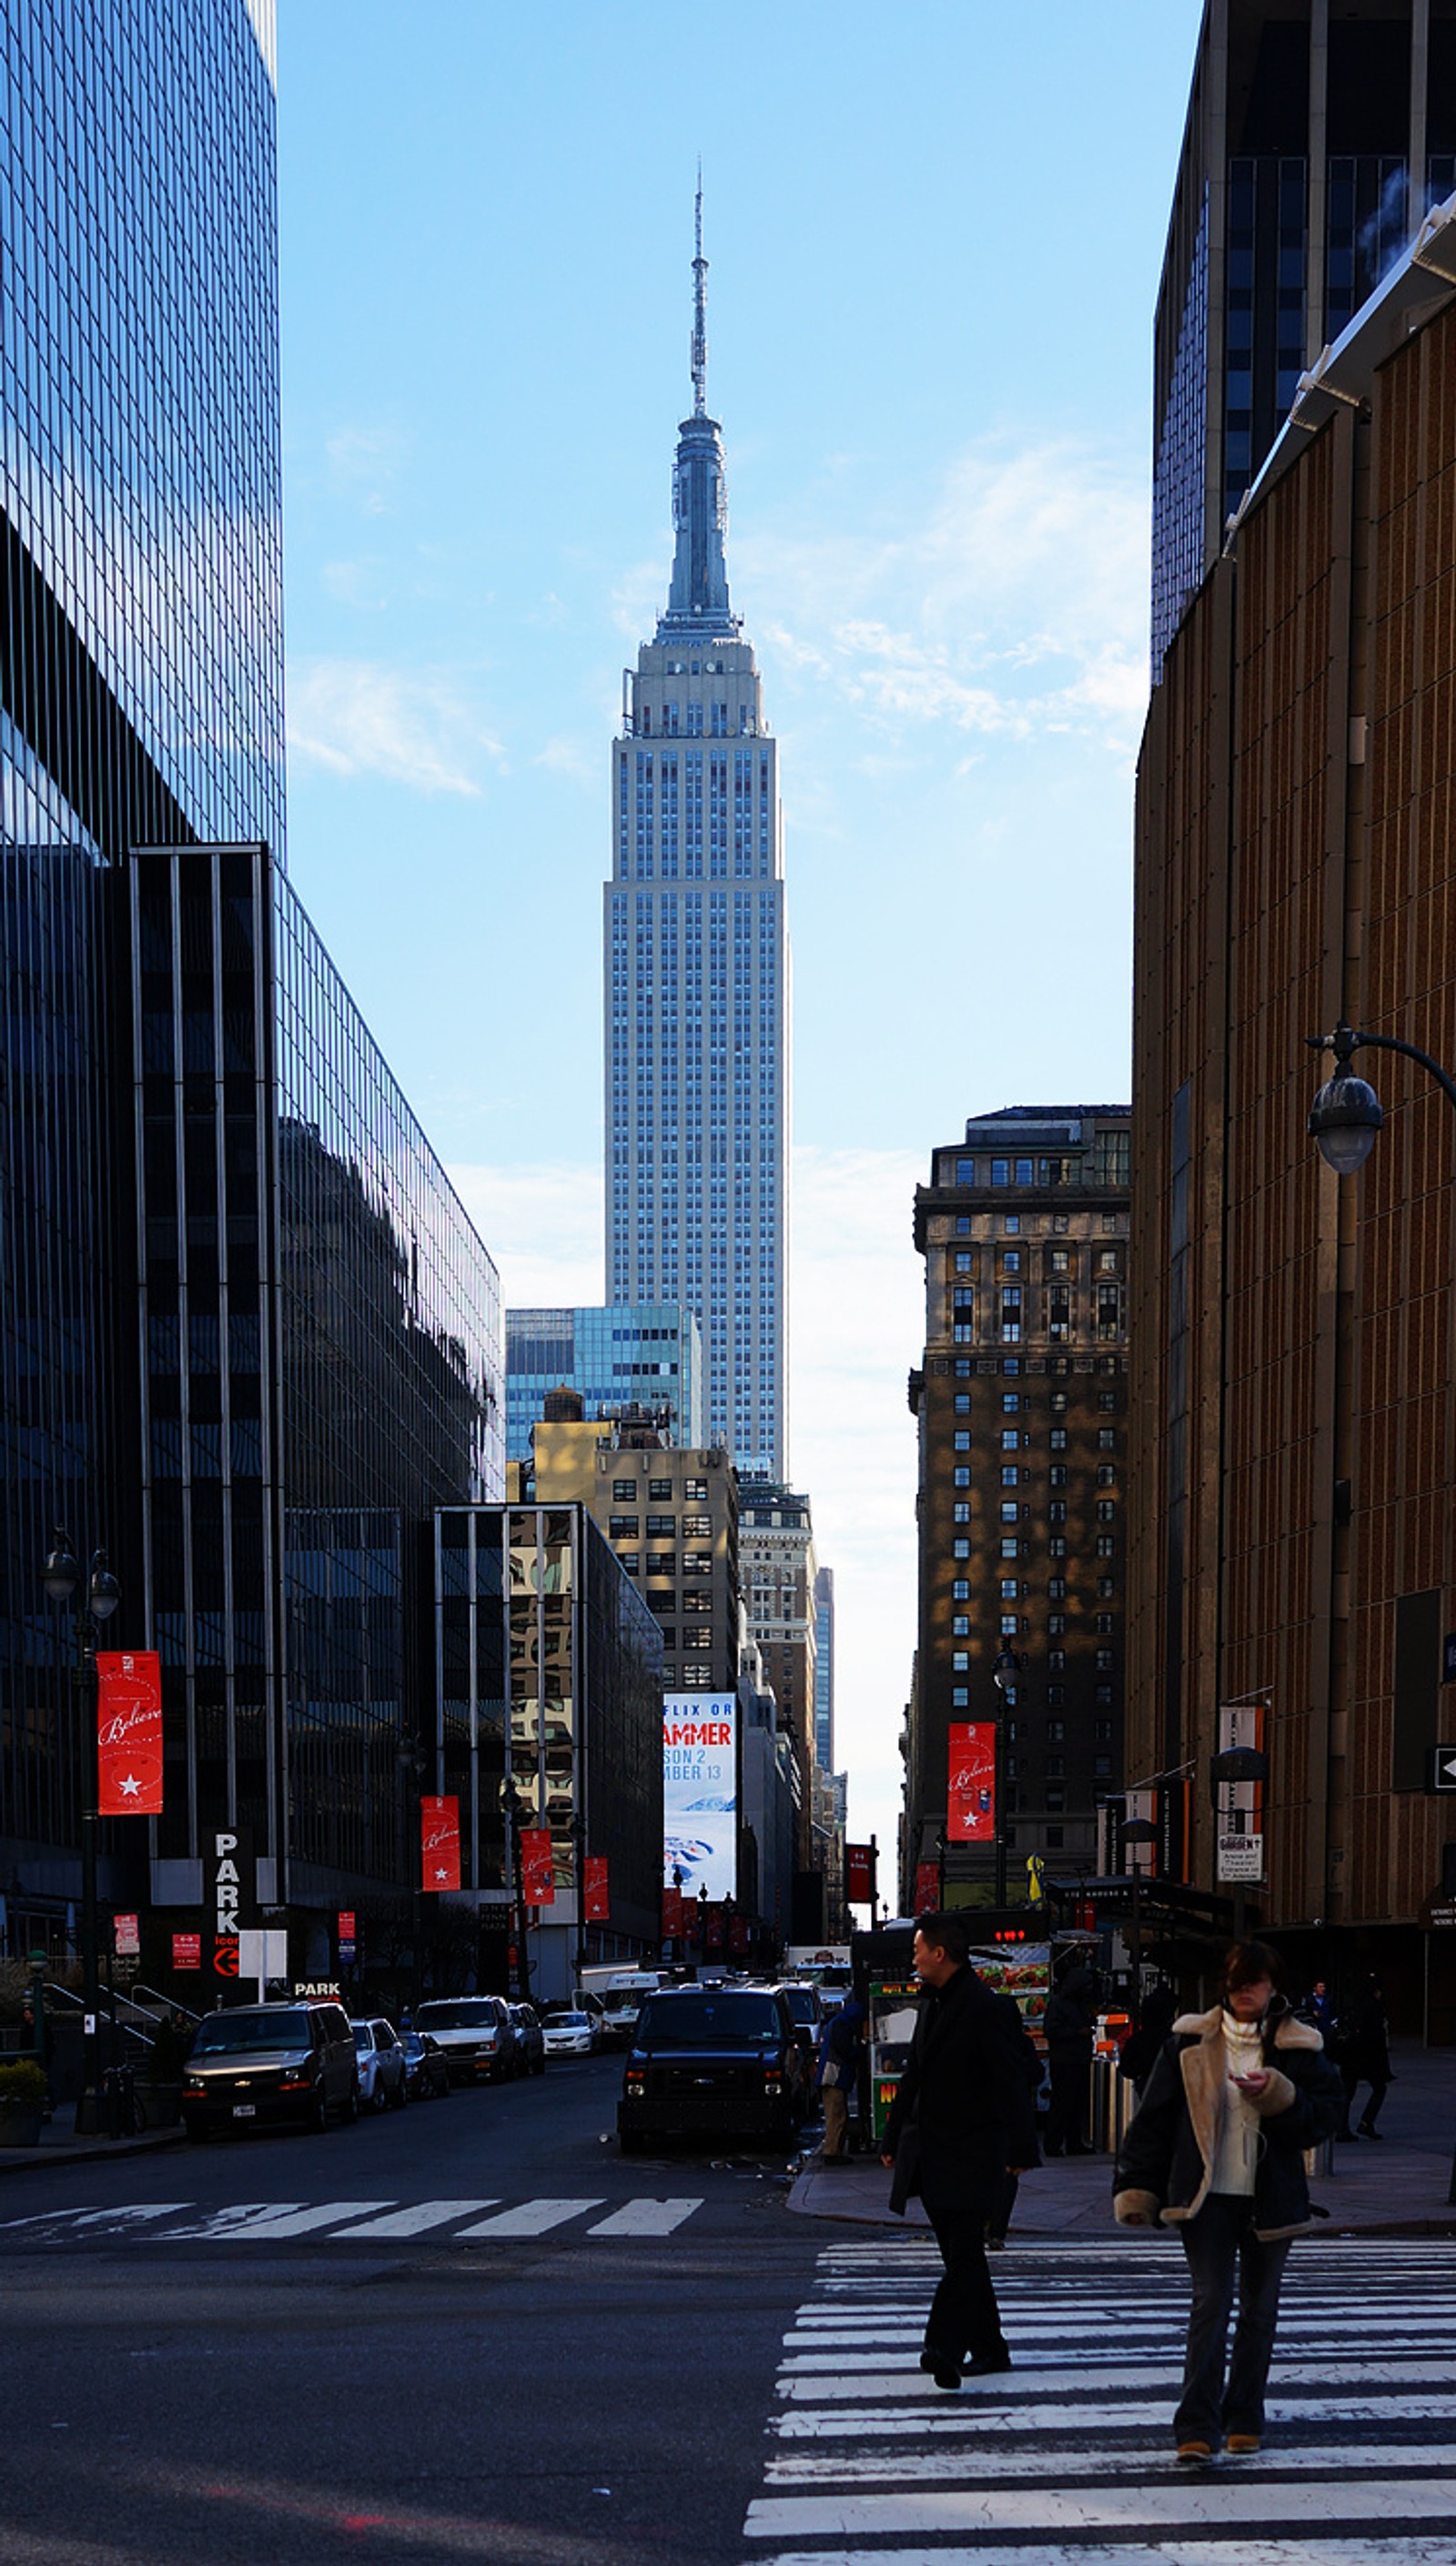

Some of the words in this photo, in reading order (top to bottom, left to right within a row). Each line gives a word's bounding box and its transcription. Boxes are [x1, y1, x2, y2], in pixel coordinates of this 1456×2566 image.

[711, 1703, 732, 1717] OR
[97, 1700, 163, 1746] Believe
[696, 1749, 705, 1764] 2
[707, 1765, 721, 1780] 13
[215, 1833, 240, 1933] PARK
[295, 1983, 340, 1996] PARK
